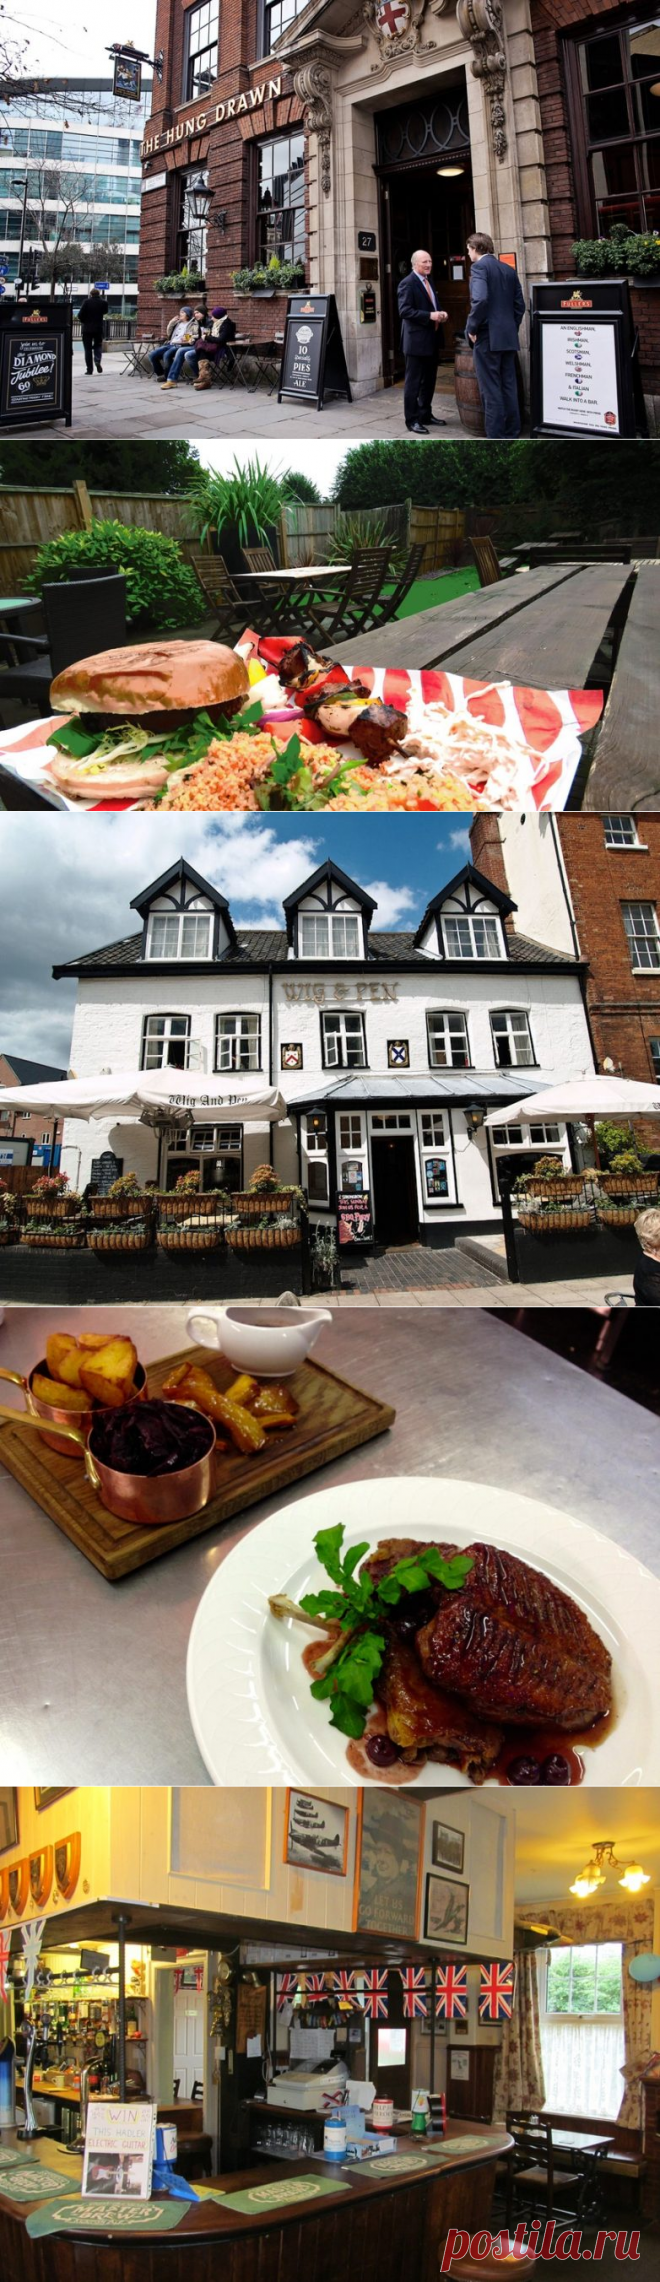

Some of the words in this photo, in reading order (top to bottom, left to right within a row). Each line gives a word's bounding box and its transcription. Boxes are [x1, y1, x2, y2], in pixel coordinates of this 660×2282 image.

[139, 134, 160, 157] THE
[166, 113, 207, 145] HUNG
[215, 77, 282, 123] DRAWN
[362, 236, 372, 247] 27
[298, 345, 308, 355] 10
[14, 352, 57, 367] DIAMOND
[293, 362, 311, 372] PIES
[11, 363, 55, 385] Jubilee!
[18, 381, 31, 391] 60
[293, 380, 307, 388] ALE
[281, 982, 325, 1005] WIG
[334, 982, 350, 1001] &
[356, 982, 400, 1001] PEN
[168, 1094, 196, 1107] Wig
[200, 1094, 223, 1106] And
[374, 1895, 389, 1907] LET
[391, 1898, 403, 1910] US
[359, 1904, 372, 1916] GO
[374, 1908, 414, 1924] FORWARD
[366, 1920, 408, 1936] TOGETHER
[109, 2109, 137, 2122] WIN
[93, 2127, 111, 2137] THIS
[116, 2128, 147, 2138] HADLER
[88, 2138, 118, 2149] ELECTRIC
[122, 2140, 147, 2149] GUITAR
[71, 2205, 152, 2217] MASTER
[79, 2212, 137, 2220] BREW
